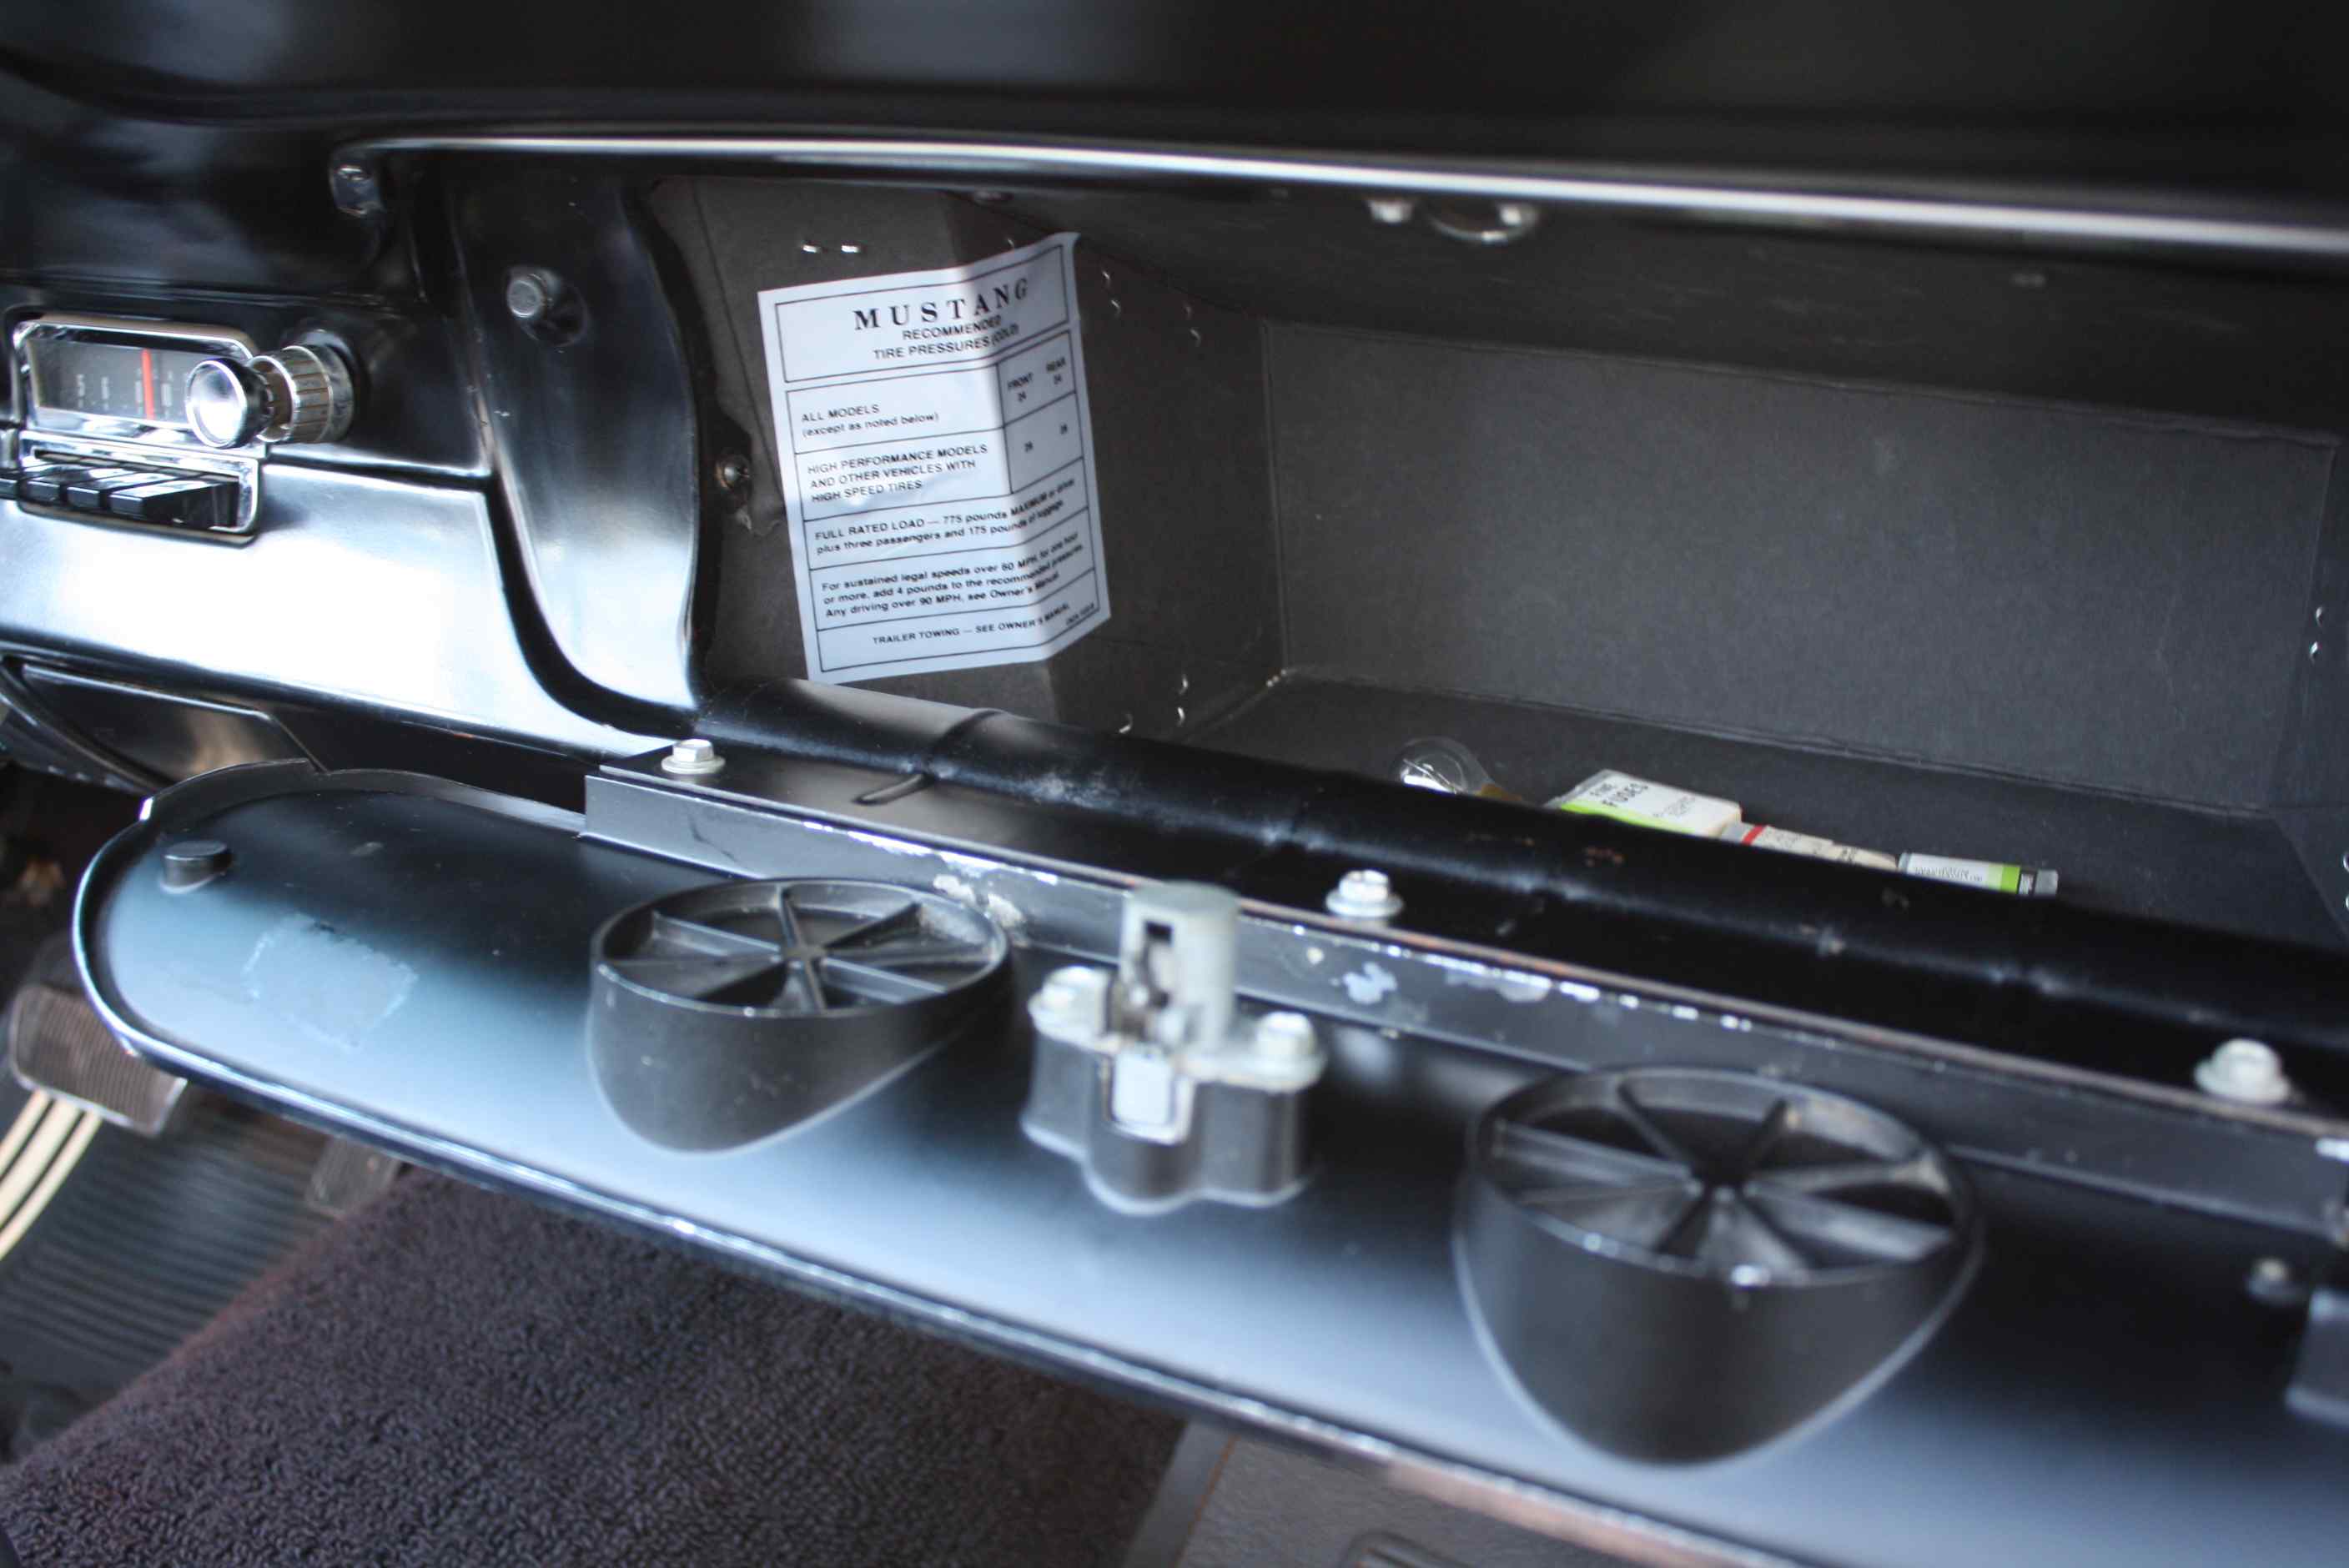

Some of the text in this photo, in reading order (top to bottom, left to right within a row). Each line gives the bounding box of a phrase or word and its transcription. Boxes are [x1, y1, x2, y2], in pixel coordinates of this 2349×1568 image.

[853, 278, 1029, 330] MUSTANG
[903, 314, 1001, 340] RECOMMENDED
[874, 347, 903, 359] TIRE
[908, 335, 989, 354] PRESSURES
[1008, 372, 1034, 389] FRONT
[802, 405, 879, 423] ALL MODELS
[802, 412, 939, 438] (except as noted below)
[807, 444, 988, 474] HIGH PERFORMANCE MODELS
[810, 460, 976, 489] AND OTHER VEHICLES WITH
[811, 480, 923, 503] HIGH SPEED TIRES
[815, 530, 844, 540] FULL
[848, 522, 888, 535] RATED
[891, 519, 924, 530] LOAD
[943, 515, 963, 525] 775
[965, 511, 1008, 525] pounds
[817, 544, 841, 555] plus
[844, 540, 873, 550] three
[876, 532, 941, 547] passengers
[944, 528, 964, 538] and
[969, 527, 987, 535] 175
[990, 520, 1028, 535] pounds
[822, 582, 840, 591] For
[844, 574, 898, 589] sustained
[902, 571, 928, 583] legal
[932, 565, 969, 580] speeds
[974, 565, 998, 574] over
[823, 596, 834, 605] or
[873, 587, 893, 598] add
[907, 582, 948, 596] pounds
[965, 579, 983, 587] the
[986, 561, 1050, 585] recommended
[825, 609, 846, 620] Any
[850, 601, 888, 615] driving
[989, 586, 1033, 598] Owner's
[873, 632, 916, 645] TRAILER
[919, 628, 960, 640] TOWING
[975, 623, 995, 633] SEE
[998, 616, 1043, 631] OWNER'S
[1044, 602, 1070, 621] MANUAL
